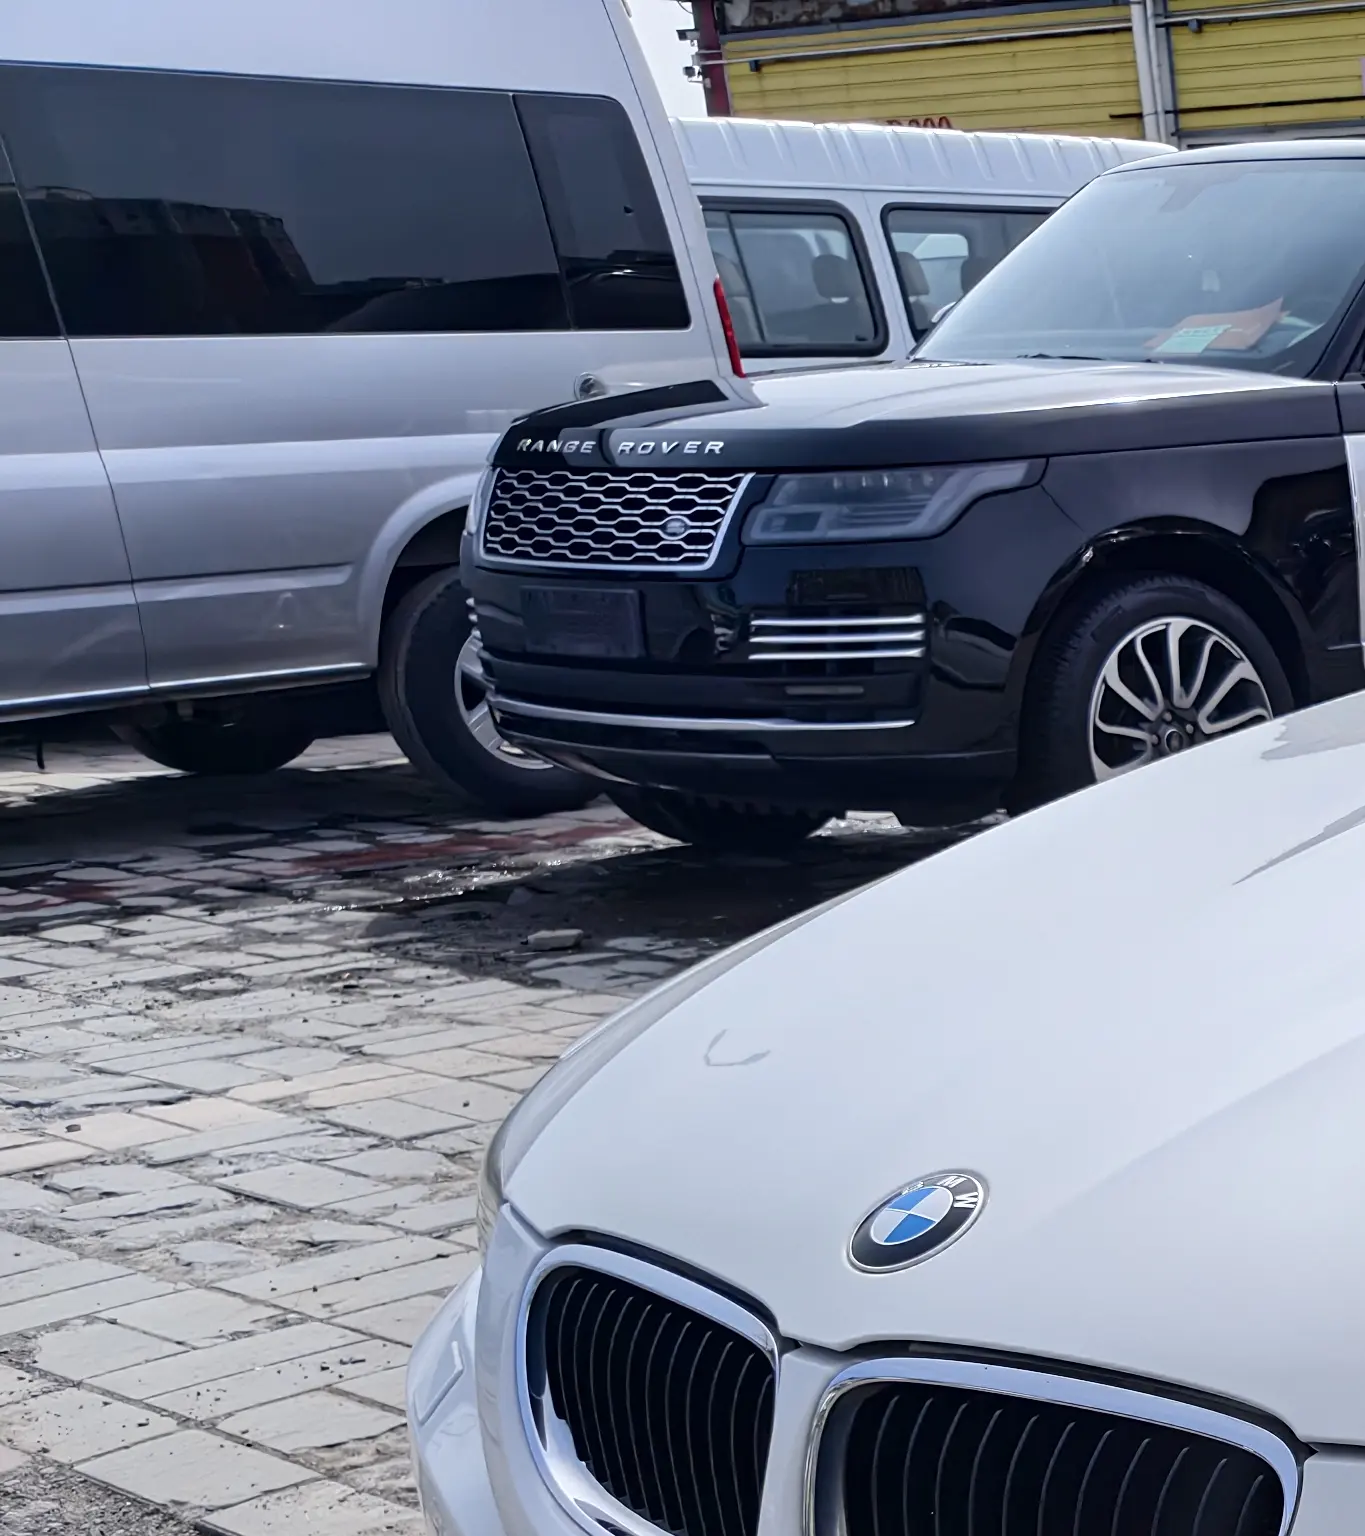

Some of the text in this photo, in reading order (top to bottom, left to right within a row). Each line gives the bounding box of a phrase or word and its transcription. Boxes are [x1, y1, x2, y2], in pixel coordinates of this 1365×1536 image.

[516, 438, 725, 455] RANGE ROVER
[901, 1175, 979, 1209] BMW
